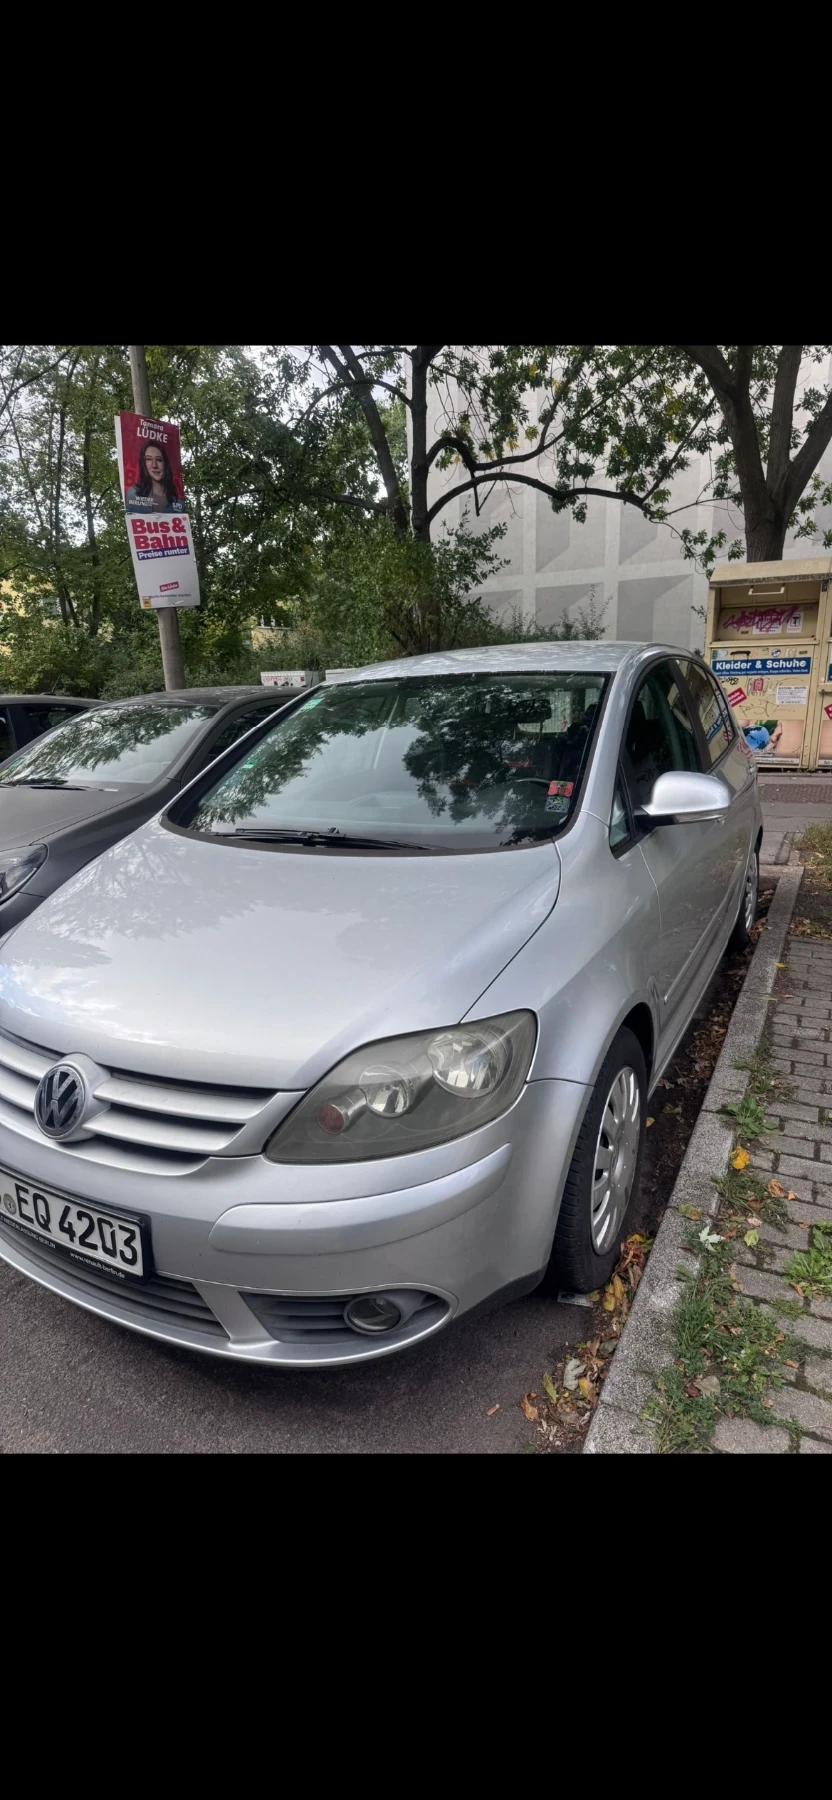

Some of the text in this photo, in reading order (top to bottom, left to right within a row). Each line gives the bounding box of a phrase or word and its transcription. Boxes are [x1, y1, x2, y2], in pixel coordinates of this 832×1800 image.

[140, 418, 164, 431] Tamara
[136, 426, 168, 443] LÜDKE
[134, 534, 189, 550] Bahn
[138, 547, 188, 559] Preise runter
[716, 659, 807, 670] Kleider & Schuhe
[39, 1067, 83, 1134] VW
[14, 1182, 138, 1266] EQ 4203
[3, 1217, 56, 1249] NIEDERLASSUNG BERLIN
[69, 1251, 126, 1279] www.renault-berlin.de
